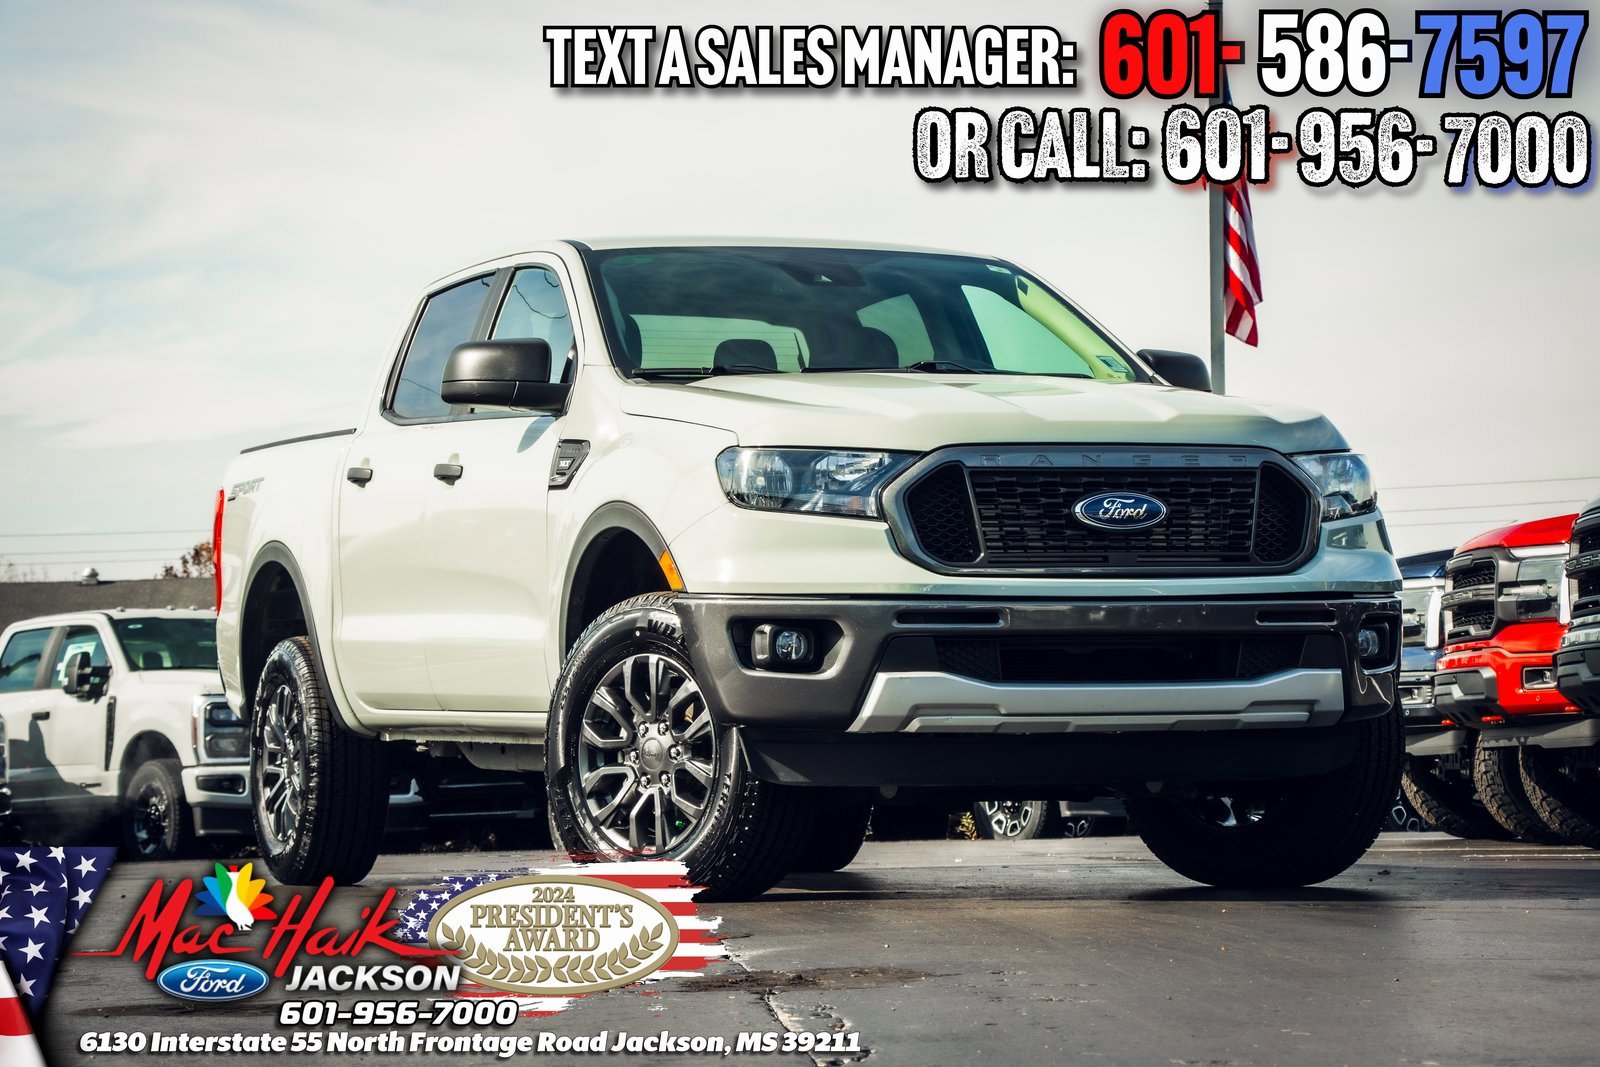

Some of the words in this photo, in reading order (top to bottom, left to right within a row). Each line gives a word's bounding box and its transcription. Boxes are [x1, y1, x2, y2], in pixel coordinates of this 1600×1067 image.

[979, 454, 1248, 466] RANGER
[230, 477, 265, 495] SPORT
[1099, 497, 1148, 519] Ford
